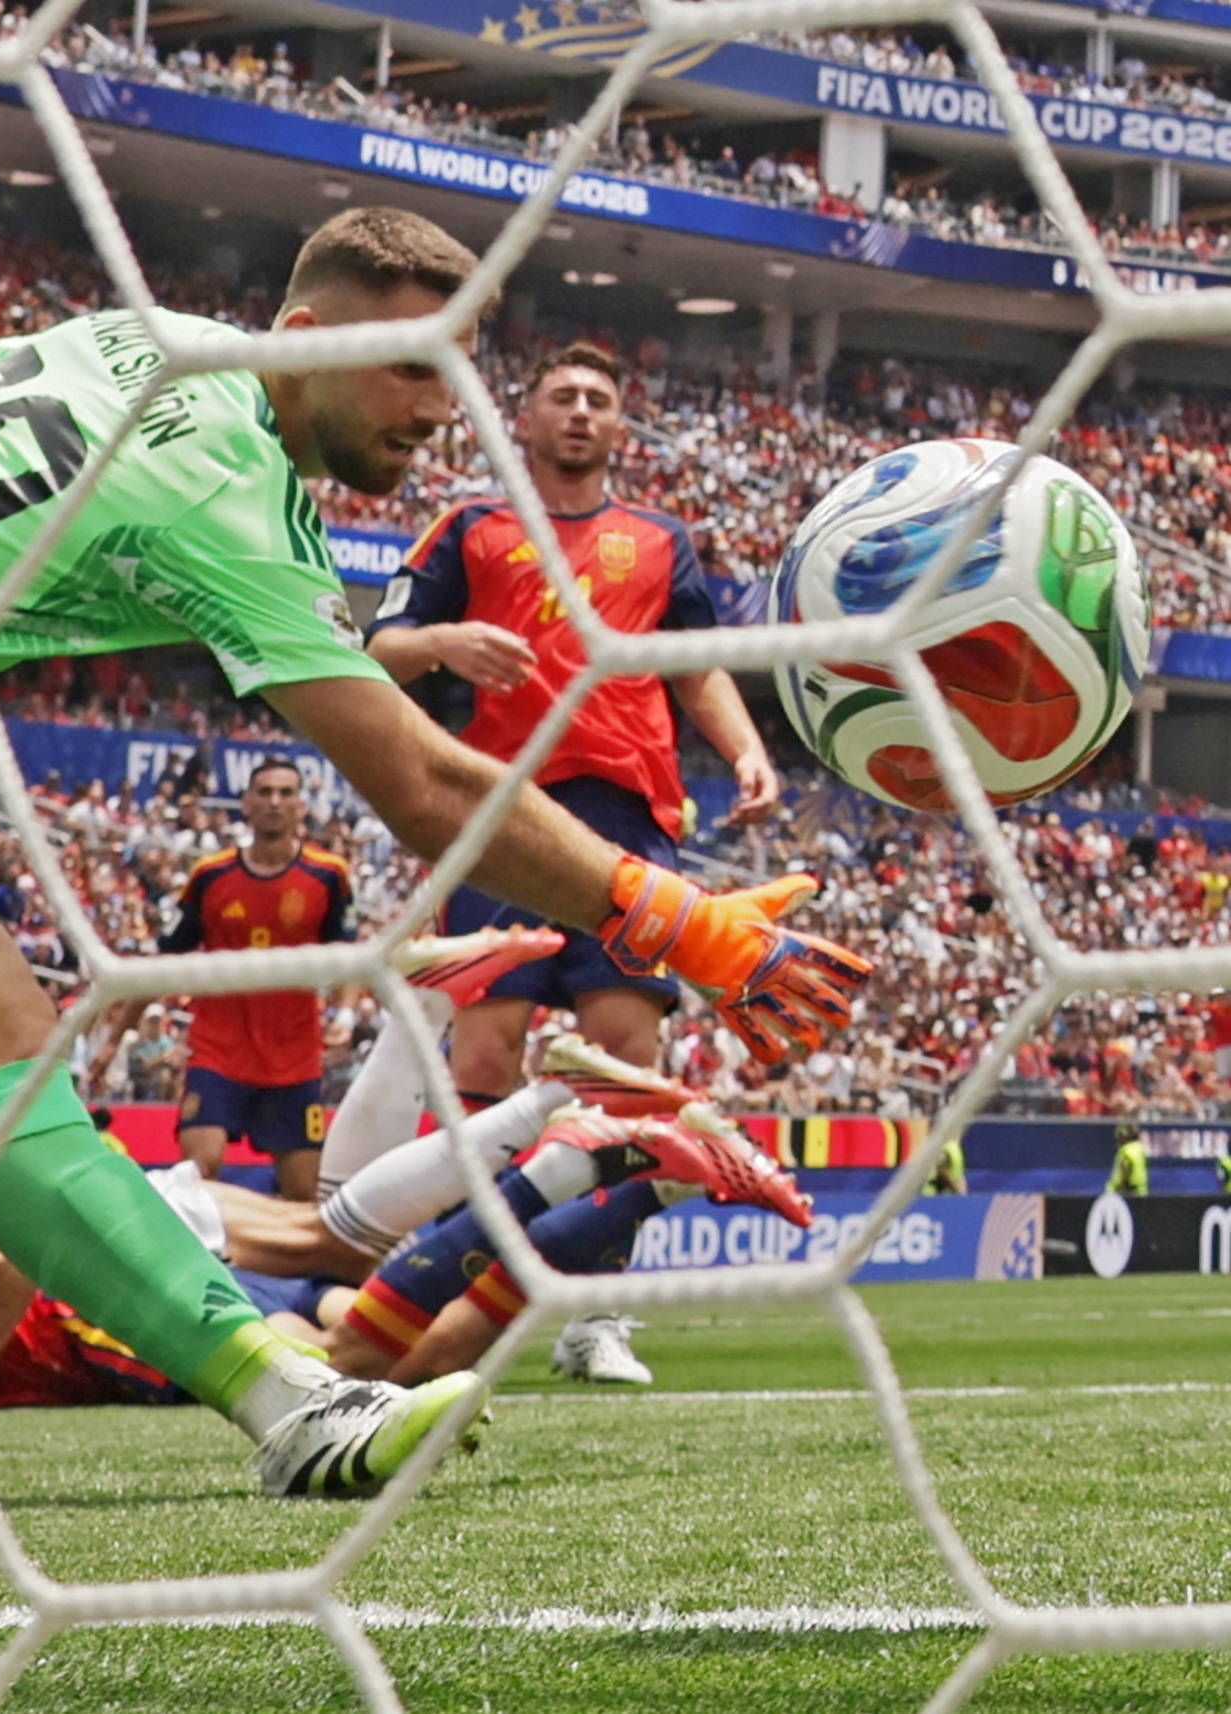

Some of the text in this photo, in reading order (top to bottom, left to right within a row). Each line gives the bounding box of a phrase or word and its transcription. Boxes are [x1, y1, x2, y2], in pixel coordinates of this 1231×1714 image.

[816, 66, 892, 114] FIFA
[897, 81, 1008, 131] WORL
[1041, 102, 1118, 143] CUP
[361, 133, 417, 172] FIFA
[416, 144, 509, 190] WORLD
[89, 315, 154, 358] NAI
[305, 1103, 325, 1142] 8
[630, 1215, 719, 1269] RLD
[724, 1214, 803, 1265] CUP
